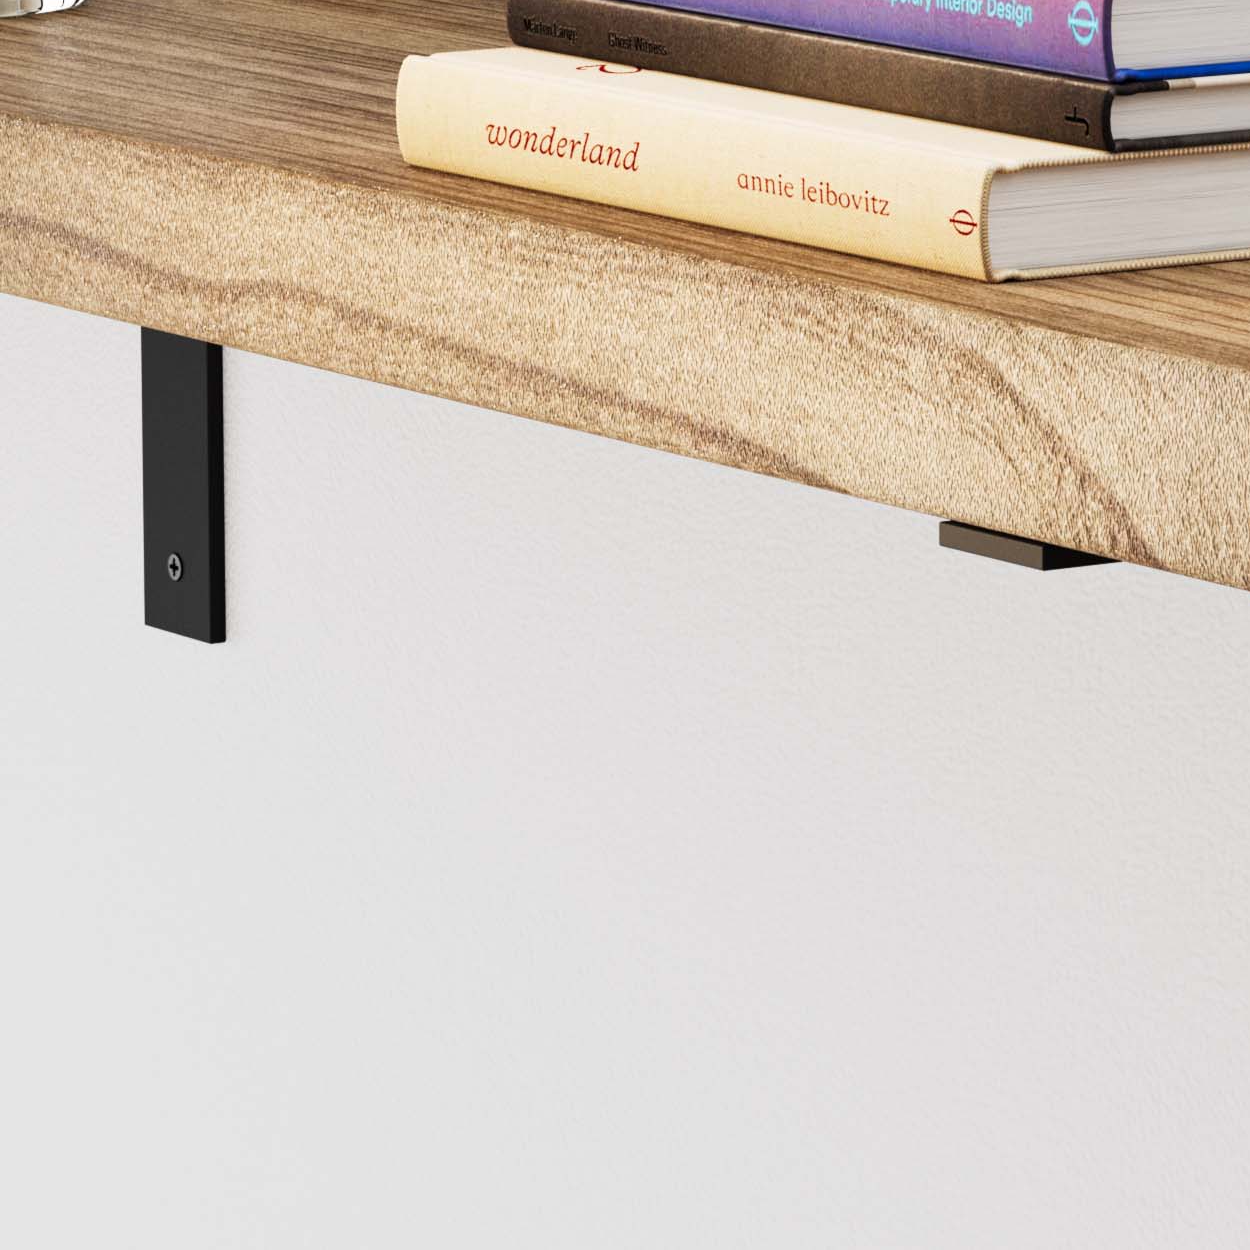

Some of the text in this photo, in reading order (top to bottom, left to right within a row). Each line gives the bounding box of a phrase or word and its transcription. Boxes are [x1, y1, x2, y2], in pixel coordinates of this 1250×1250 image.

[486, 123, 640, 172] wonderland
[737, 168, 891, 217] annie leibovitz
